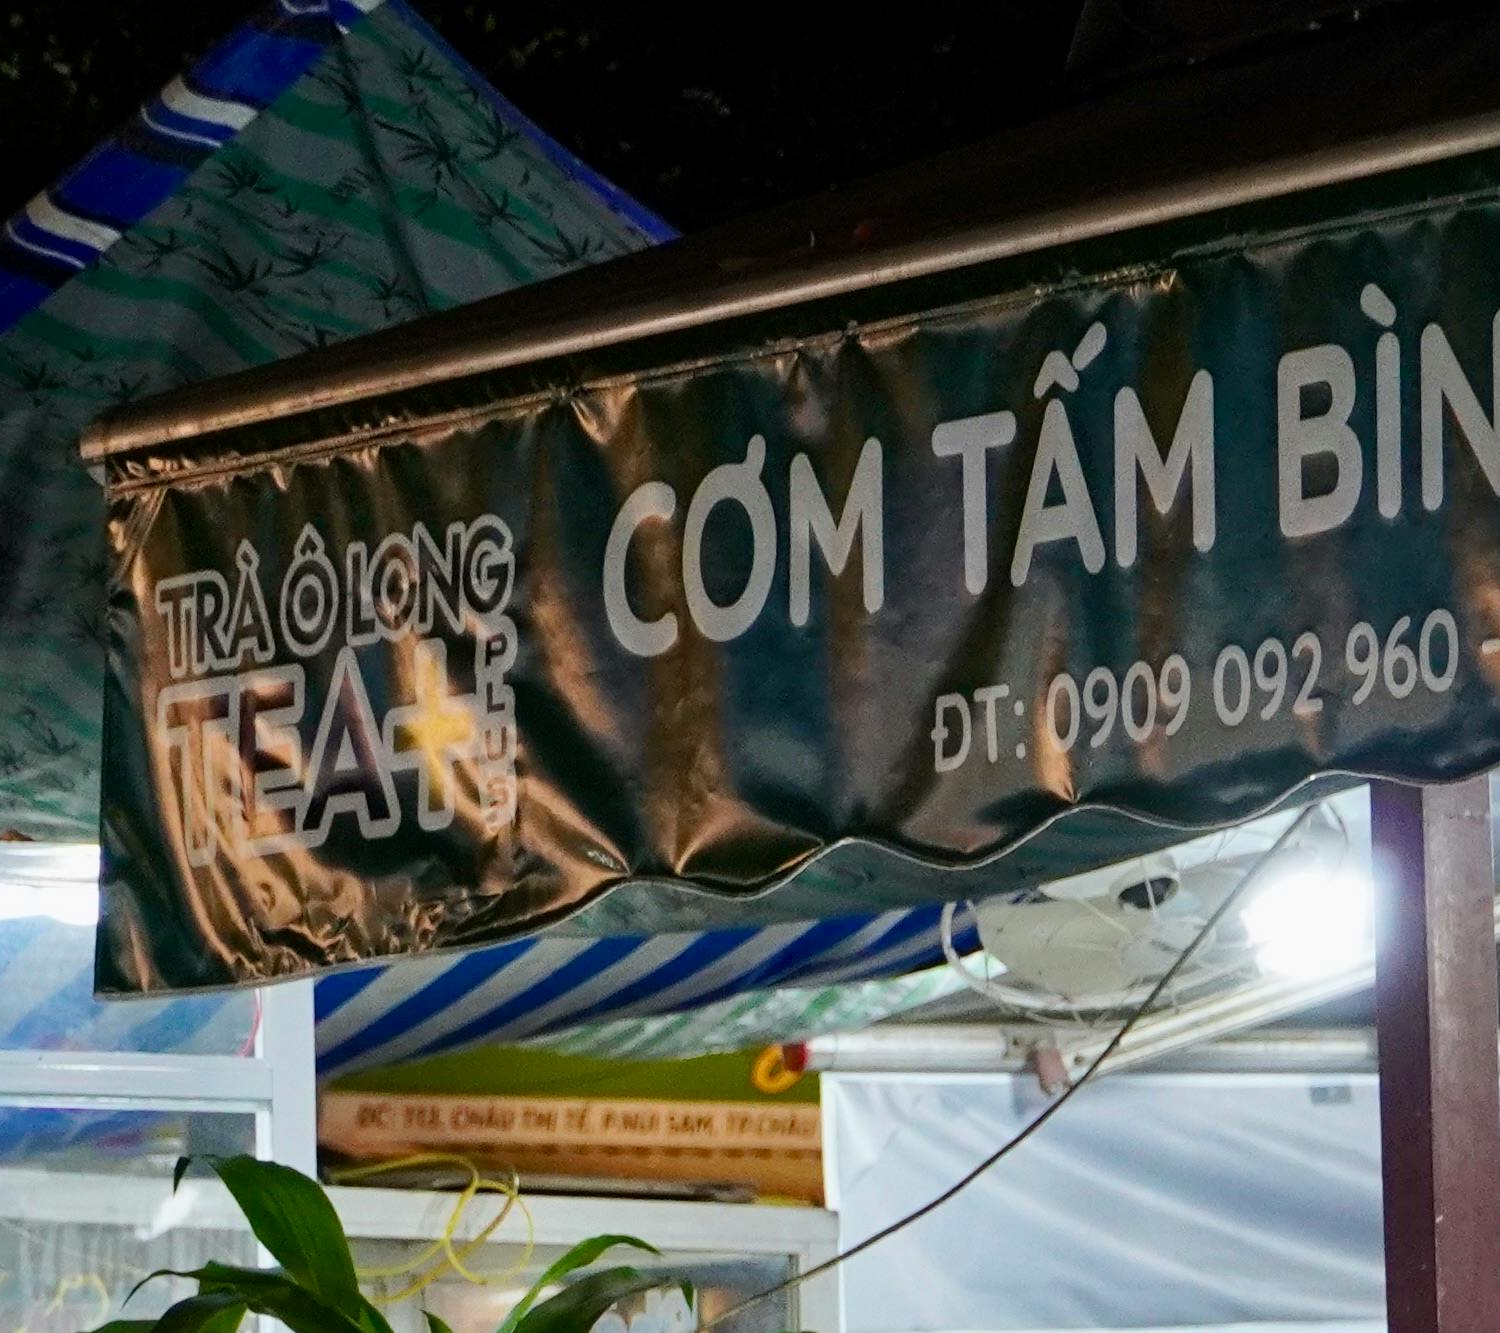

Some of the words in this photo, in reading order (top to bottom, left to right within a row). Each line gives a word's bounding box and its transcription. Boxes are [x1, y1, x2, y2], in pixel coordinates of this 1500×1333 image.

[603, 434, 884, 658] CƠM
[931, 322, 1216, 595] TẤM
[156, 538, 276, 679] TRÀ
[280, 522, 340, 657] Ô
[346, 513, 515, 646] LONG
[931, 685, 1026, 772] ĐT:
[1045, 654, 1191, 753] 0909
[1212, 630, 1323, 728] 092
[1345, 608, 1459, 705] 960
